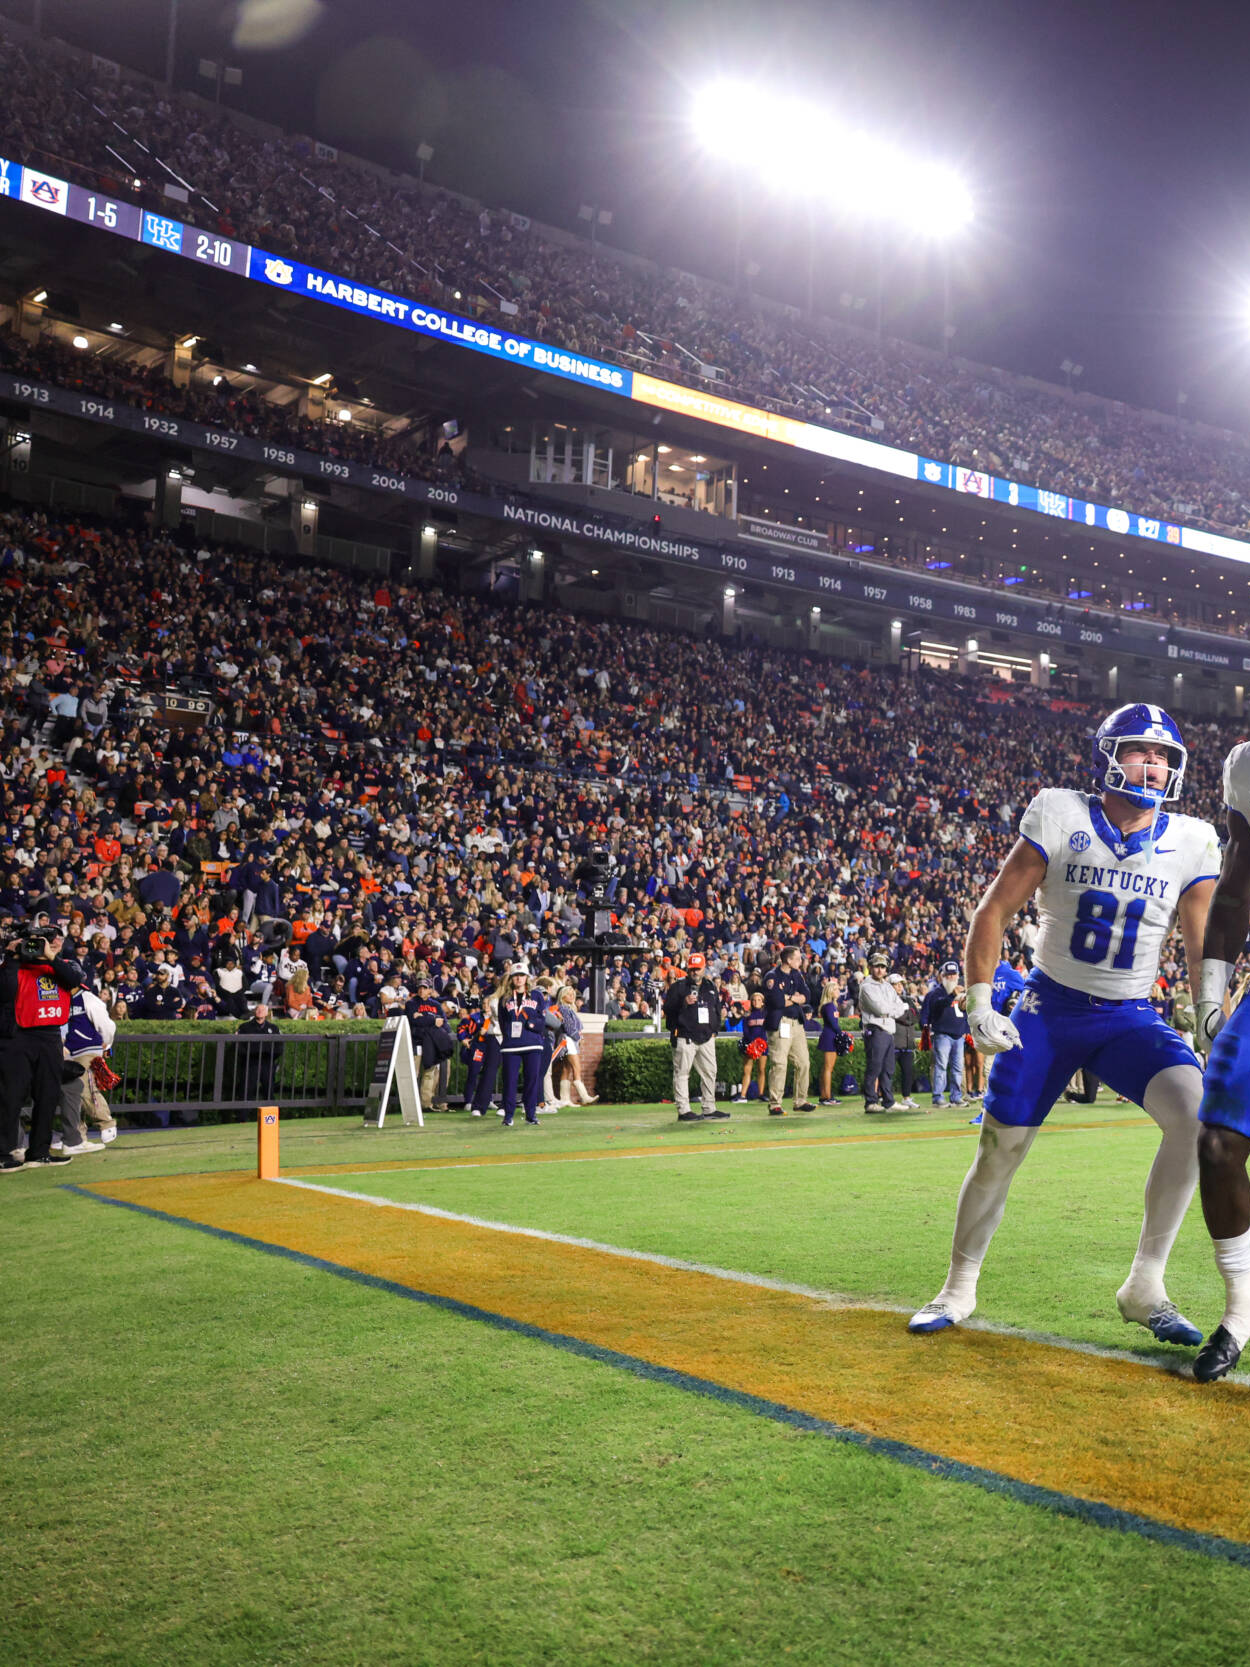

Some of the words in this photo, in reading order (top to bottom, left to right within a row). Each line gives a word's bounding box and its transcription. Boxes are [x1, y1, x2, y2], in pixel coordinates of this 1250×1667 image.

[87, 197, 118, 228] 1-5
[196, 235, 232, 266] 2-10
[307, 273, 409, 321] HARBERT
[411, 309, 501, 351] COLLEGE
[504, 339, 531, 359] OF
[534, 346, 624, 388] BUSINESS
[13, 382, 49, 402] 1913
[80, 400, 114, 420] 1914
[143, 417, 179, 436] 1932
[205, 432, 238, 450] 1957
[263, 447, 296, 465] 1958
[319, 461, 351, 479] 1993
[372, 474, 406, 492] 2004
[427, 488, 458, 504] 2010
[750, 524, 796, 543] BROADWAY
[797, 534, 819, 548] CLUB
[503, 504, 581, 535] NATIONAL
[583, 523, 700, 560] CHAMPIONSHIPS
[720, 553, 748, 571] 1910
[771, 565, 796, 582] 1913
[819, 576, 842, 592] 1914
[863, 585, 887, 601] 1957
[909, 595, 933, 611] 1958
[953, 604, 977, 619] 1983
[995, 612, 1018, 627] 1993
[1036, 621, 1062, 636] 2004
[1079, 629, 1103, 644] 2010
[1065, 863, 1169, 899] KENTUCKY
[1070, 888, 1147, 970] 81
